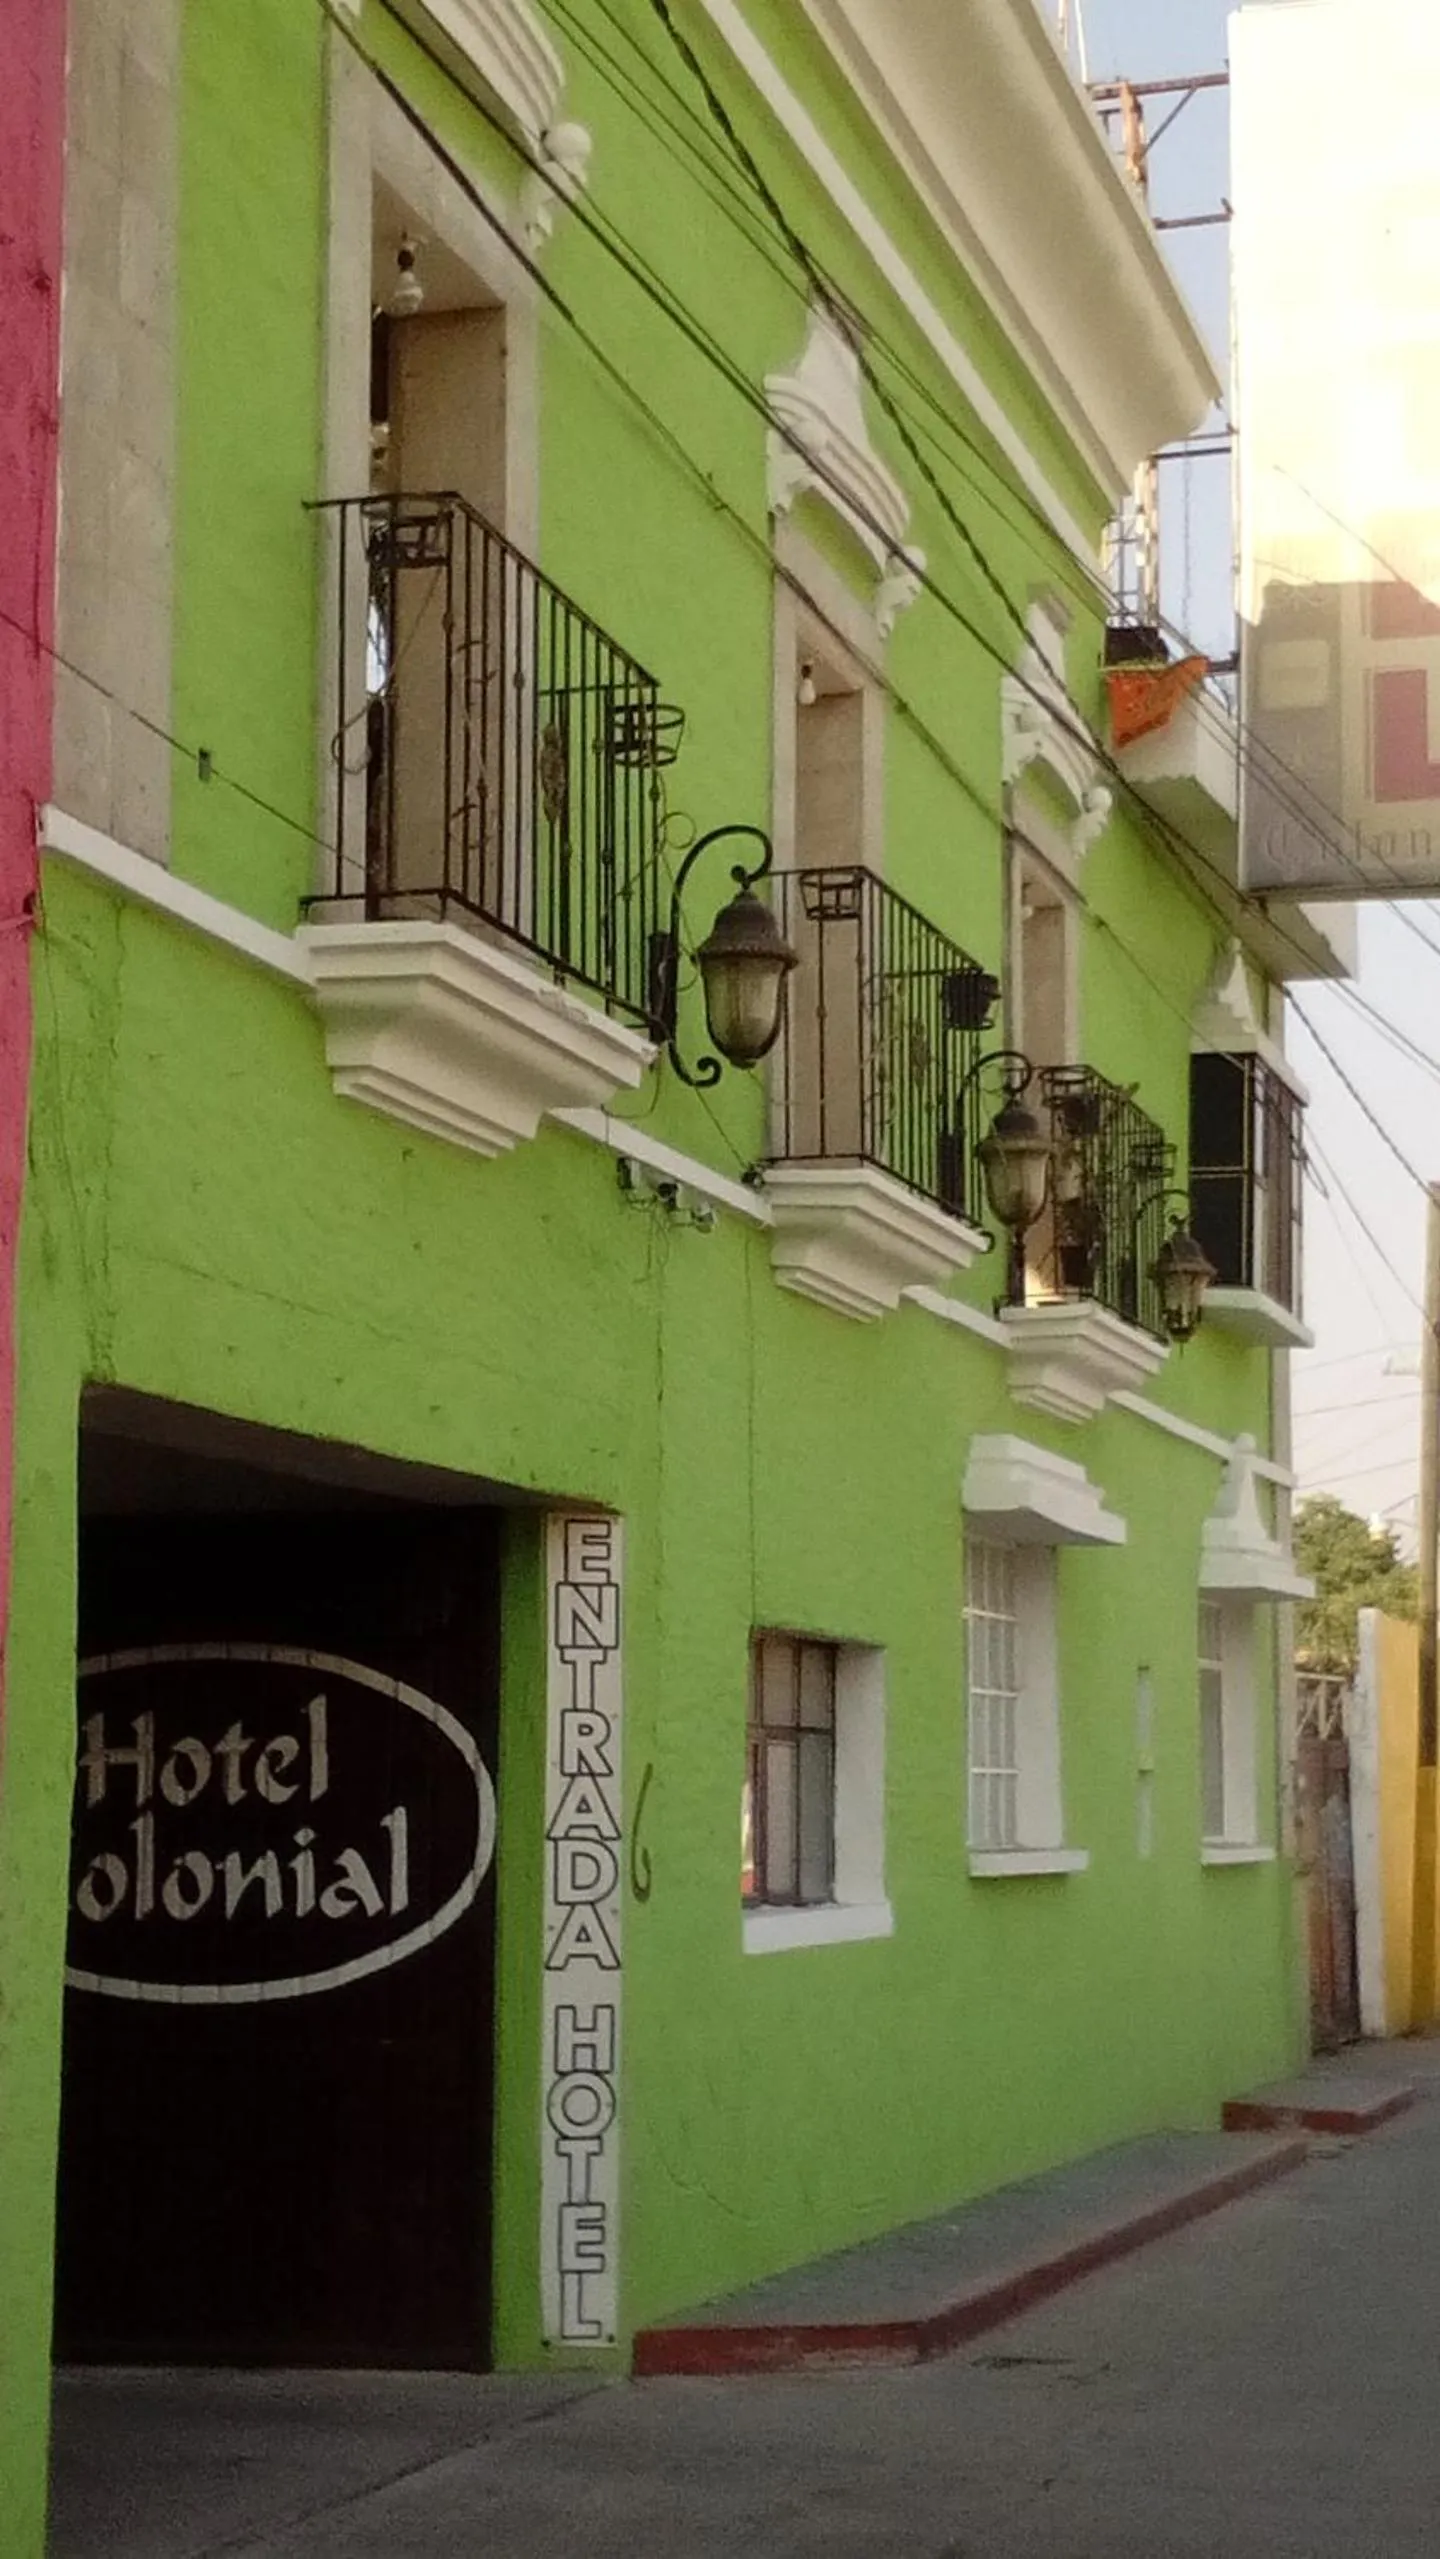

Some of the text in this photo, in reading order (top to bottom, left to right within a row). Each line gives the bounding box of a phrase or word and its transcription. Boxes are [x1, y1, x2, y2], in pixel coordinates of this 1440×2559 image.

[79, 1694, 329, 1809] Hotel
[76, 1806, 409, 1922] olonial
[546, 1519, 621, 2339] ENTRADA HOTEL
